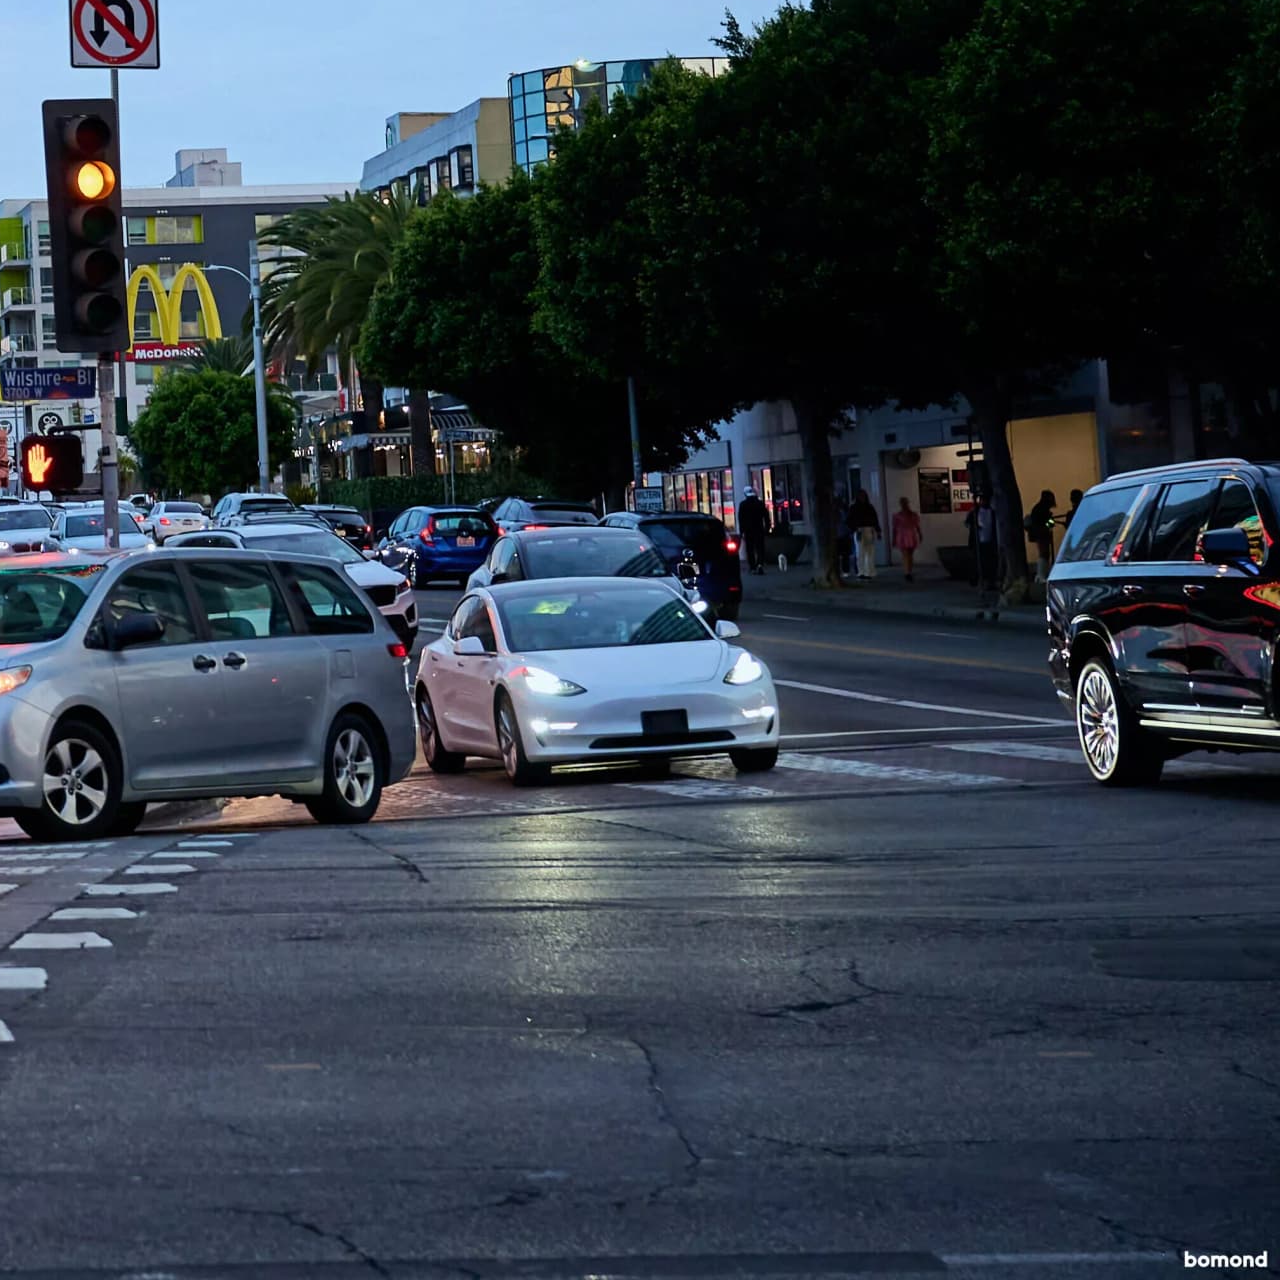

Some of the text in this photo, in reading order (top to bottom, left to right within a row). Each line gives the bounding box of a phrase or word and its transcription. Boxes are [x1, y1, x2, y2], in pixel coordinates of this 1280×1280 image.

[135, 346, 204, 359] McDon
[4, 369, 91, 387] Wilshire Bl
[4, 387, 30, 399] 3700
[34, 387, 43, 398] W
[952, 489, 970, 500] RET
